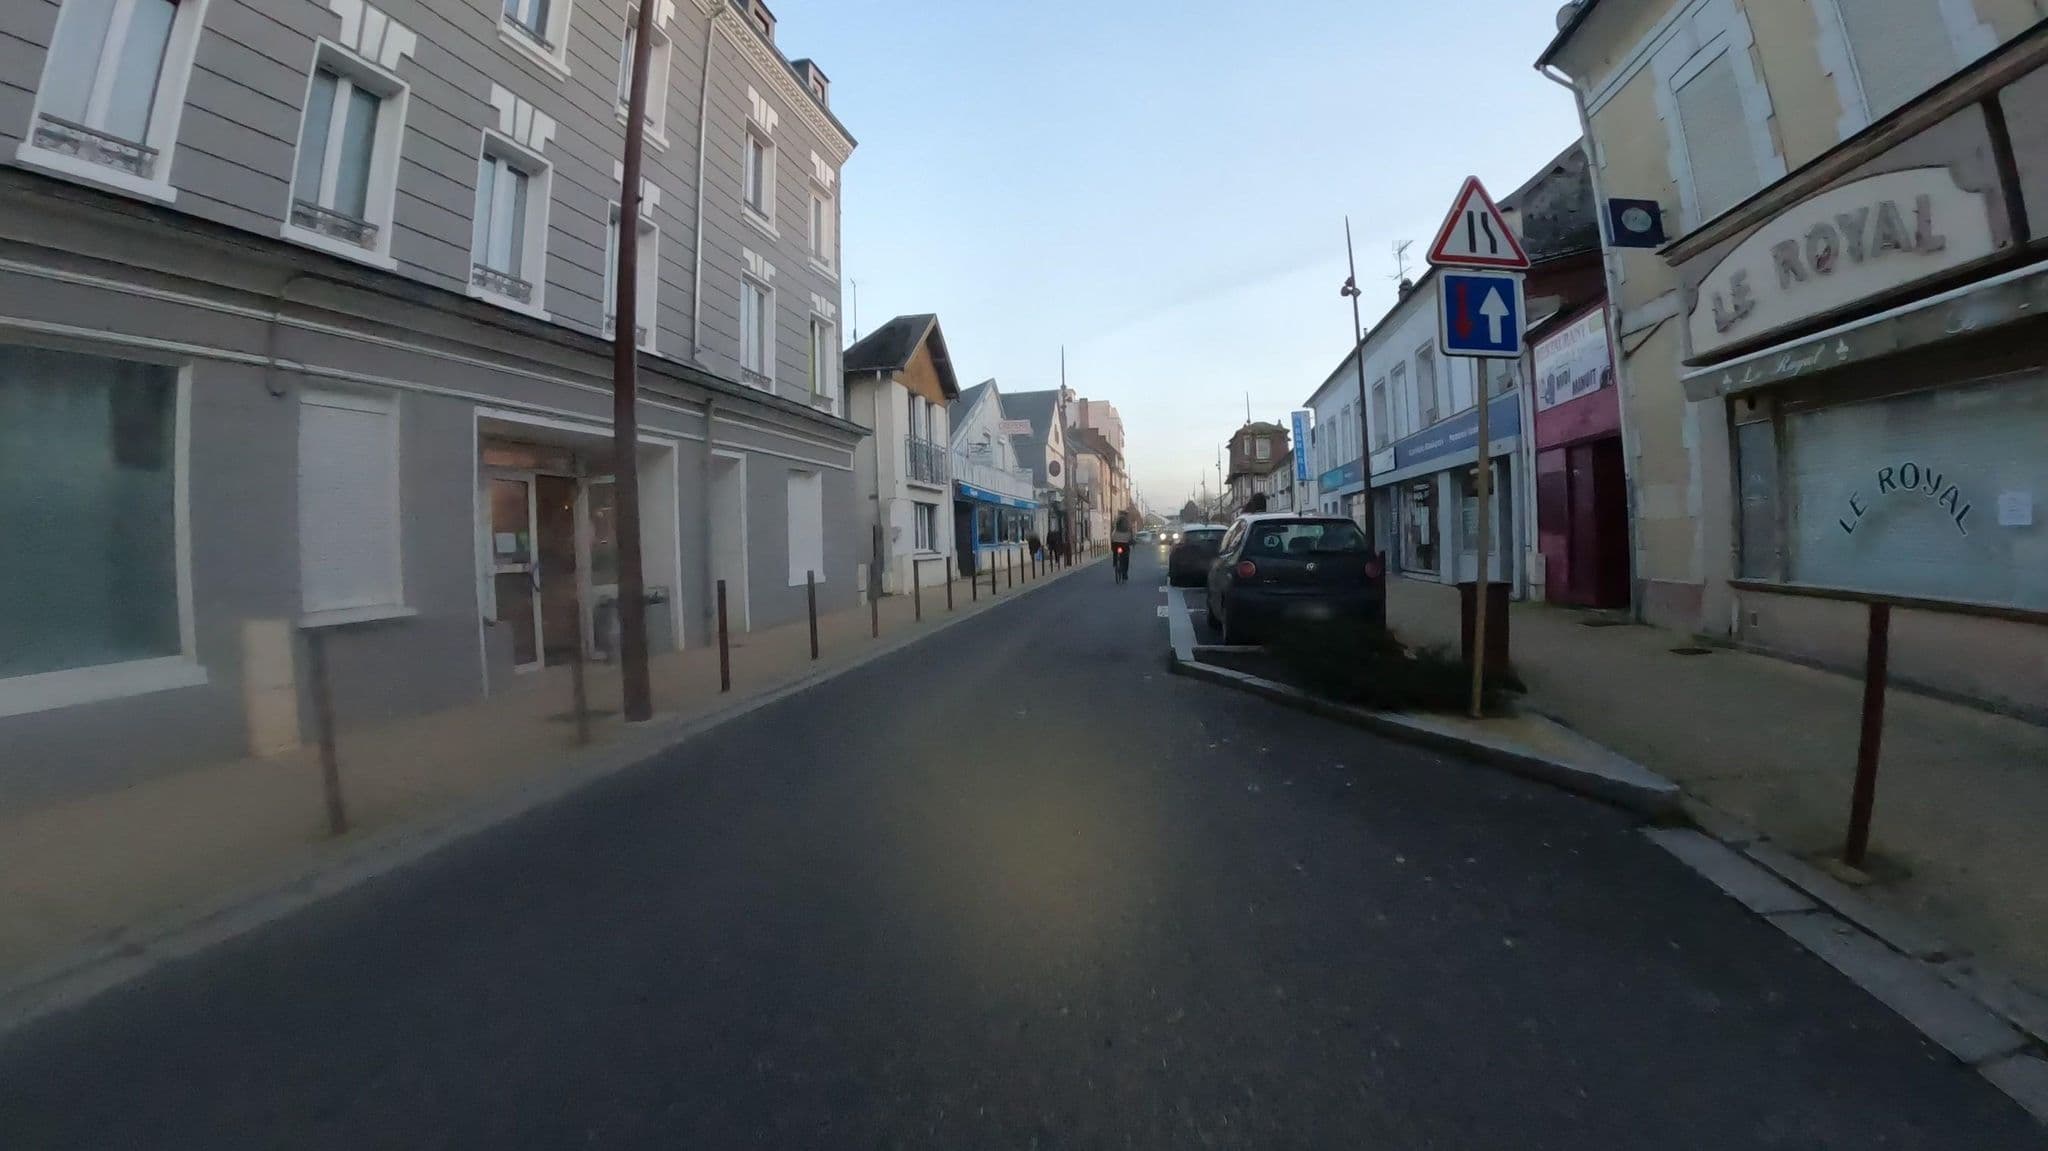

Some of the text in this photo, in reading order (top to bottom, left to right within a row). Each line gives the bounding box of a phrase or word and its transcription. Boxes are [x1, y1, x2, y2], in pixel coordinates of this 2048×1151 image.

[1713, 195, 1946, 332] LE ROYAL
[1777, 343, 1824, 375] Royal
[1839, 492, 1868, 536] LE
[1877, 461, 1973, 536] ROYAL
